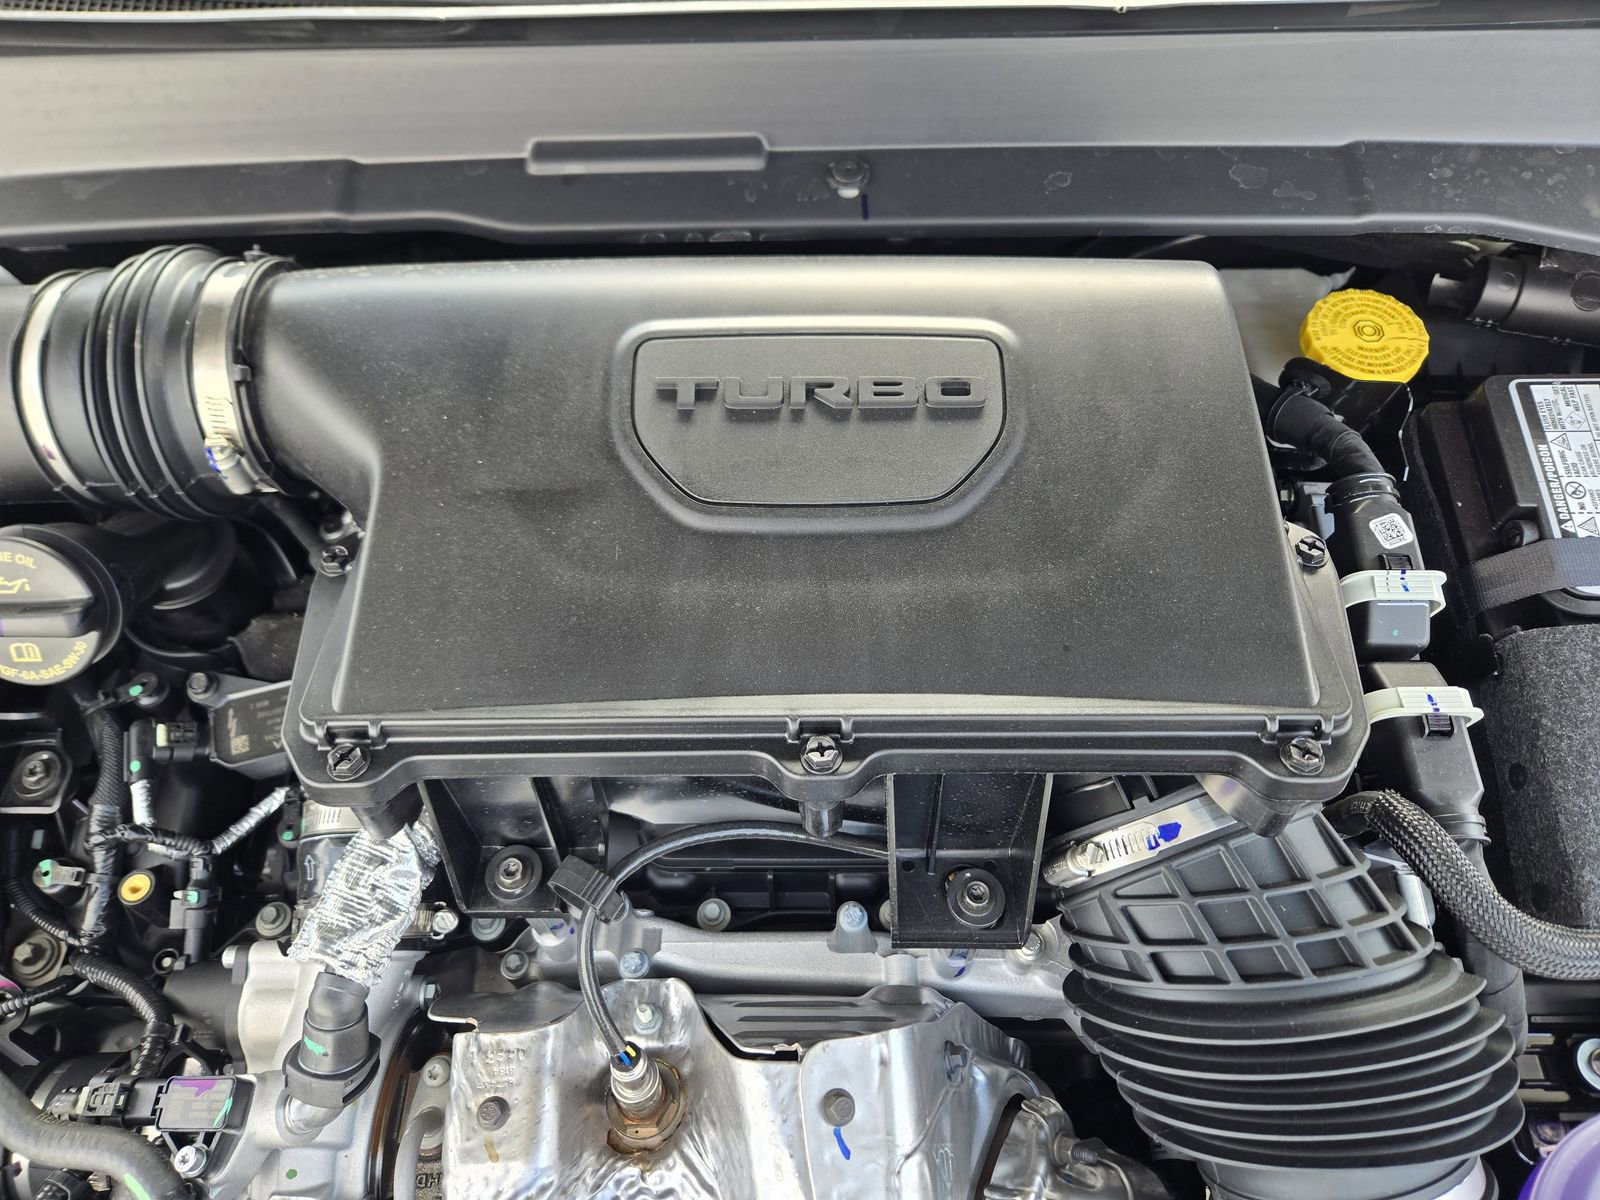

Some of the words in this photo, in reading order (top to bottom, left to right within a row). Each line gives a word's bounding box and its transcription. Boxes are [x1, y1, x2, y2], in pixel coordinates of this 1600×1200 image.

[655, 376, 986, 411] TURBO
[1536, 444, 1571, 520] DANGER/POISON
[15, 553, 37, 569] OIL
